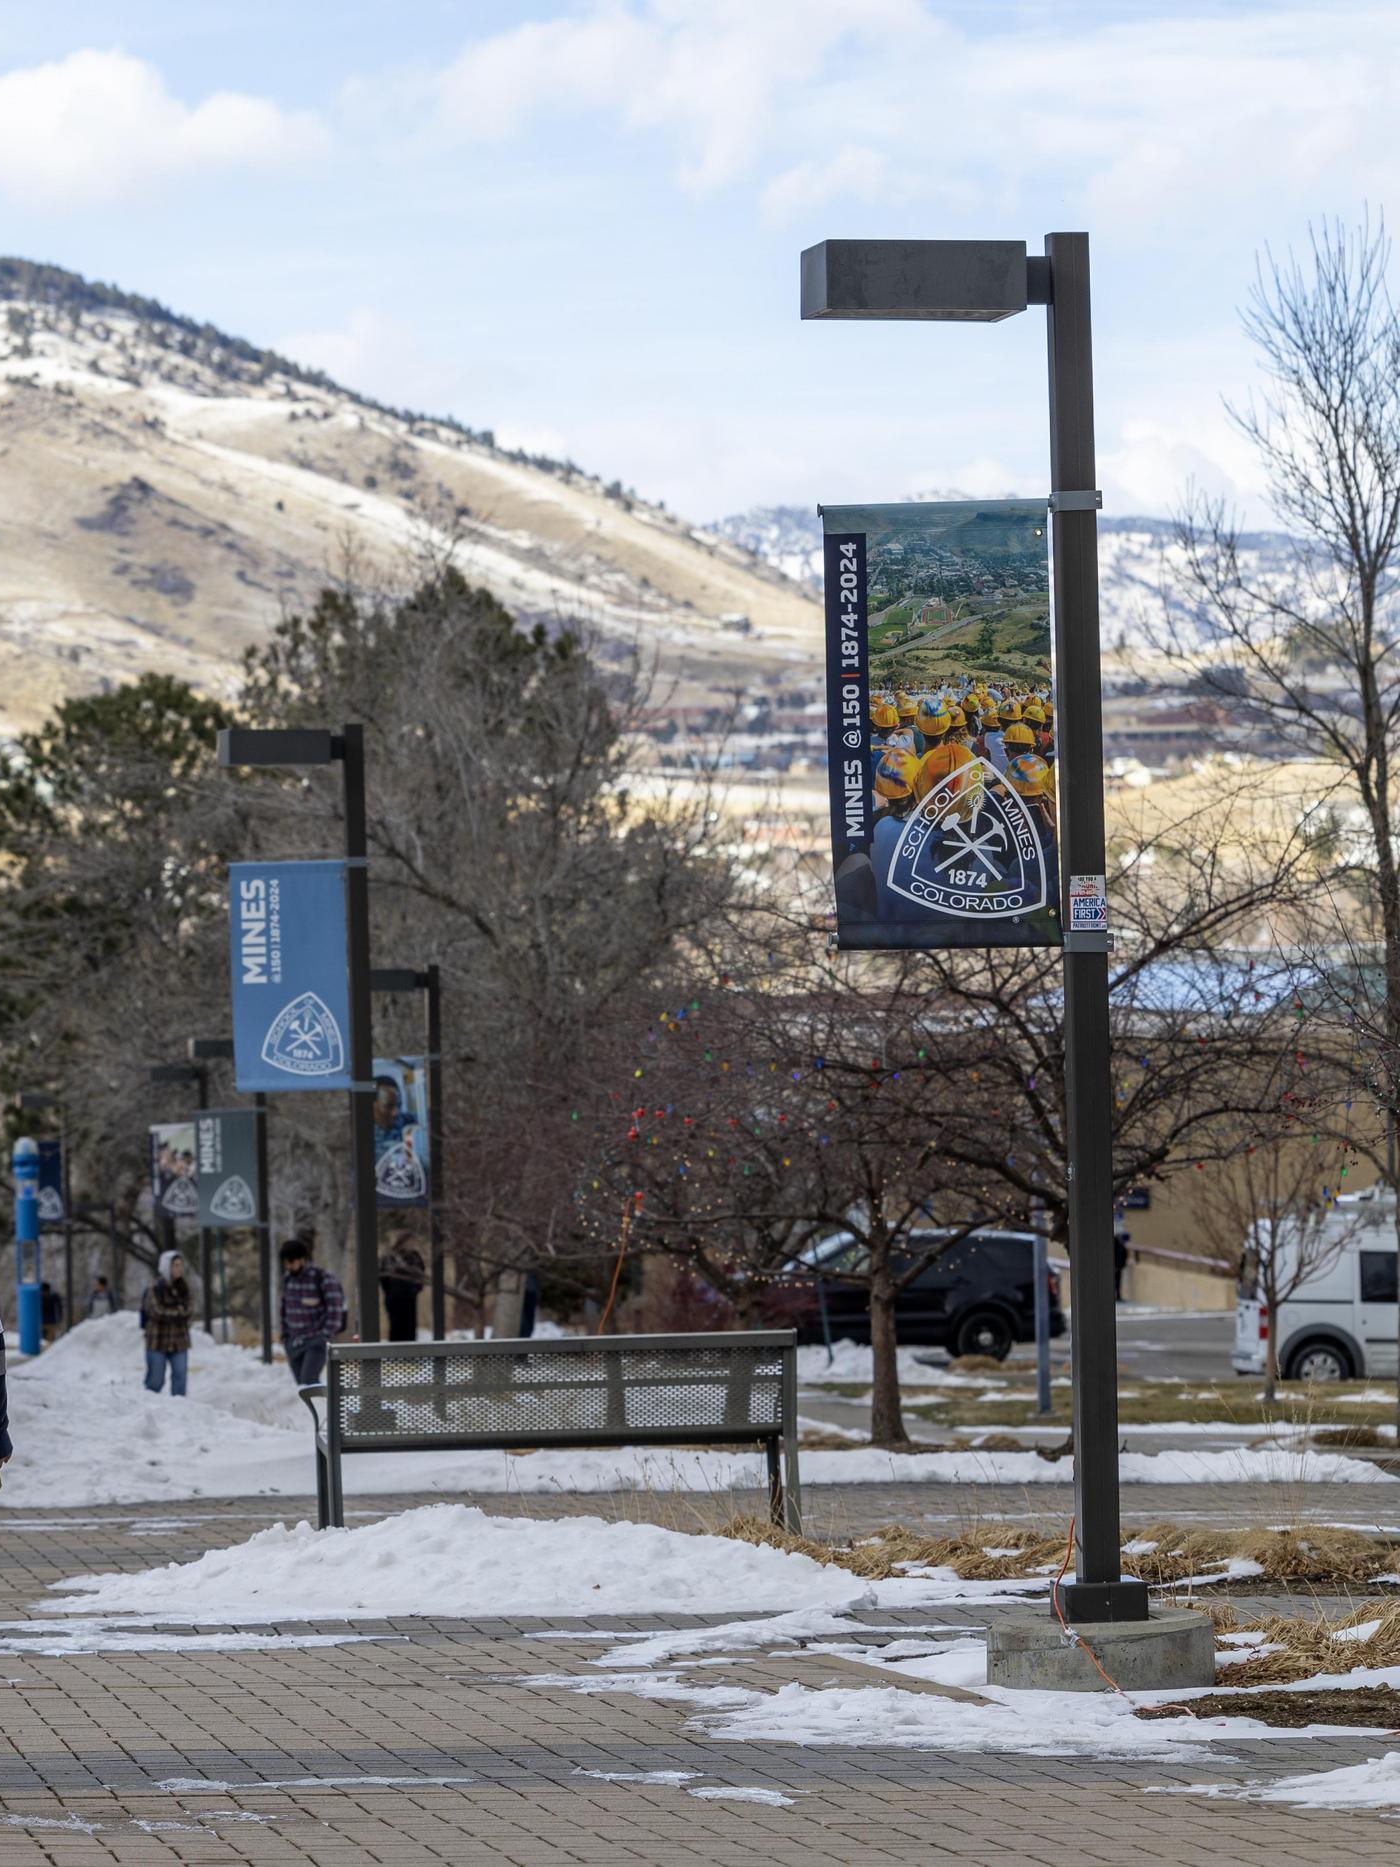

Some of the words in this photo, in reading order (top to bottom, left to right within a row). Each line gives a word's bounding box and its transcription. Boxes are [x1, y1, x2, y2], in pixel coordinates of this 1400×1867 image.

[839, 542, 860, 668] 1874-2024
[842, 684, 862, 748] @150
[844, 759, 865, 837] MINES
[902, 787, 960, 860] SCHOOL
[969, 769, 991, 782] OF
[1002, 798, 1036, 861] MINES
[909, 881, 1024, 911] COLORADO
[947, 868, 988, 888] 1874
[1073, 897, 1106, 907] AMERICA
[240, 878, 268, 985] MINES
[269, 879, 281, 942] 1874-2024
[1074, 908, 1096, 919] FIRST
[198, 1117, 215, 1174] MINES
